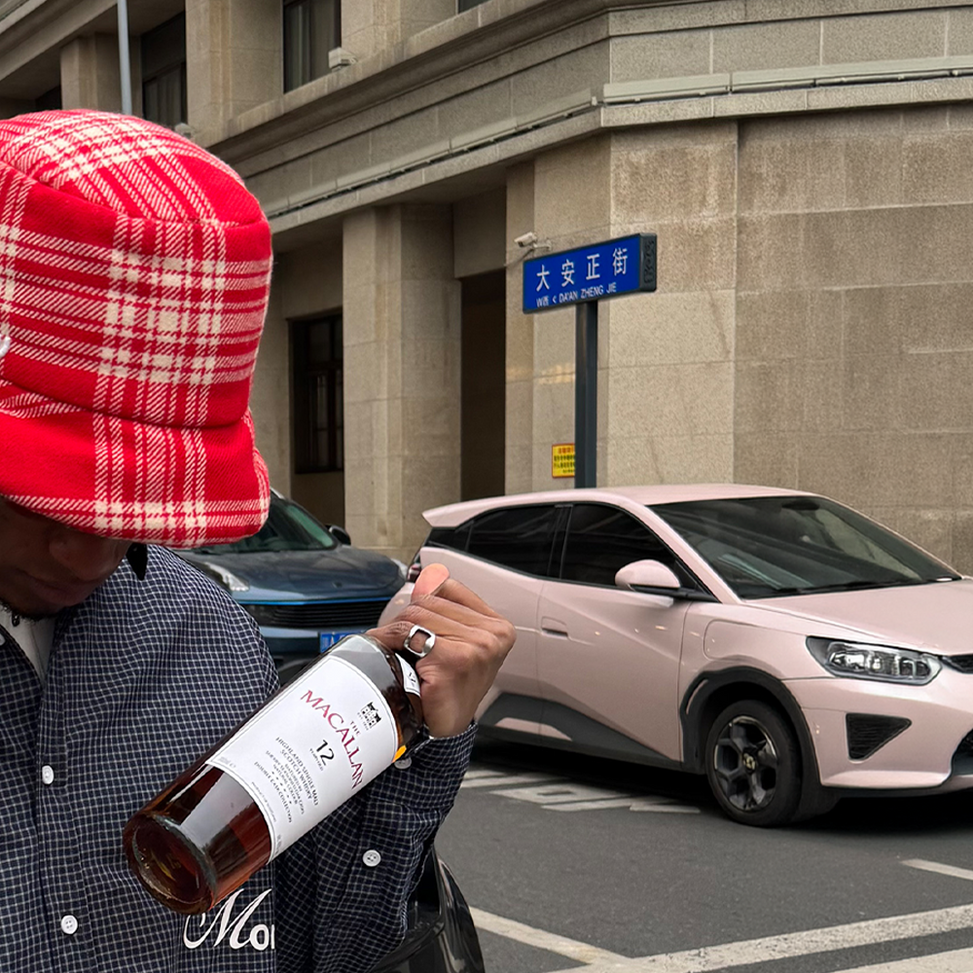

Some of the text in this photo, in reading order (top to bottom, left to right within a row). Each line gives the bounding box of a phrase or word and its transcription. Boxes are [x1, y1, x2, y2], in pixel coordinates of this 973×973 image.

[536, 247, 627, 292] 大安正街
[580, 285, 604, 299] ZHENG
[606, 282, 617, 294] JIE
[300, 690, 364, 789] MACALLAN
[350, 721, 361, 736] THE
[276, 737, 304, 767] HIGHLAND
[302, 766, 315, 788] SINGLE
[281, 749, 302, 774] SCOTCH
[316, 739, 335, 766] 12
